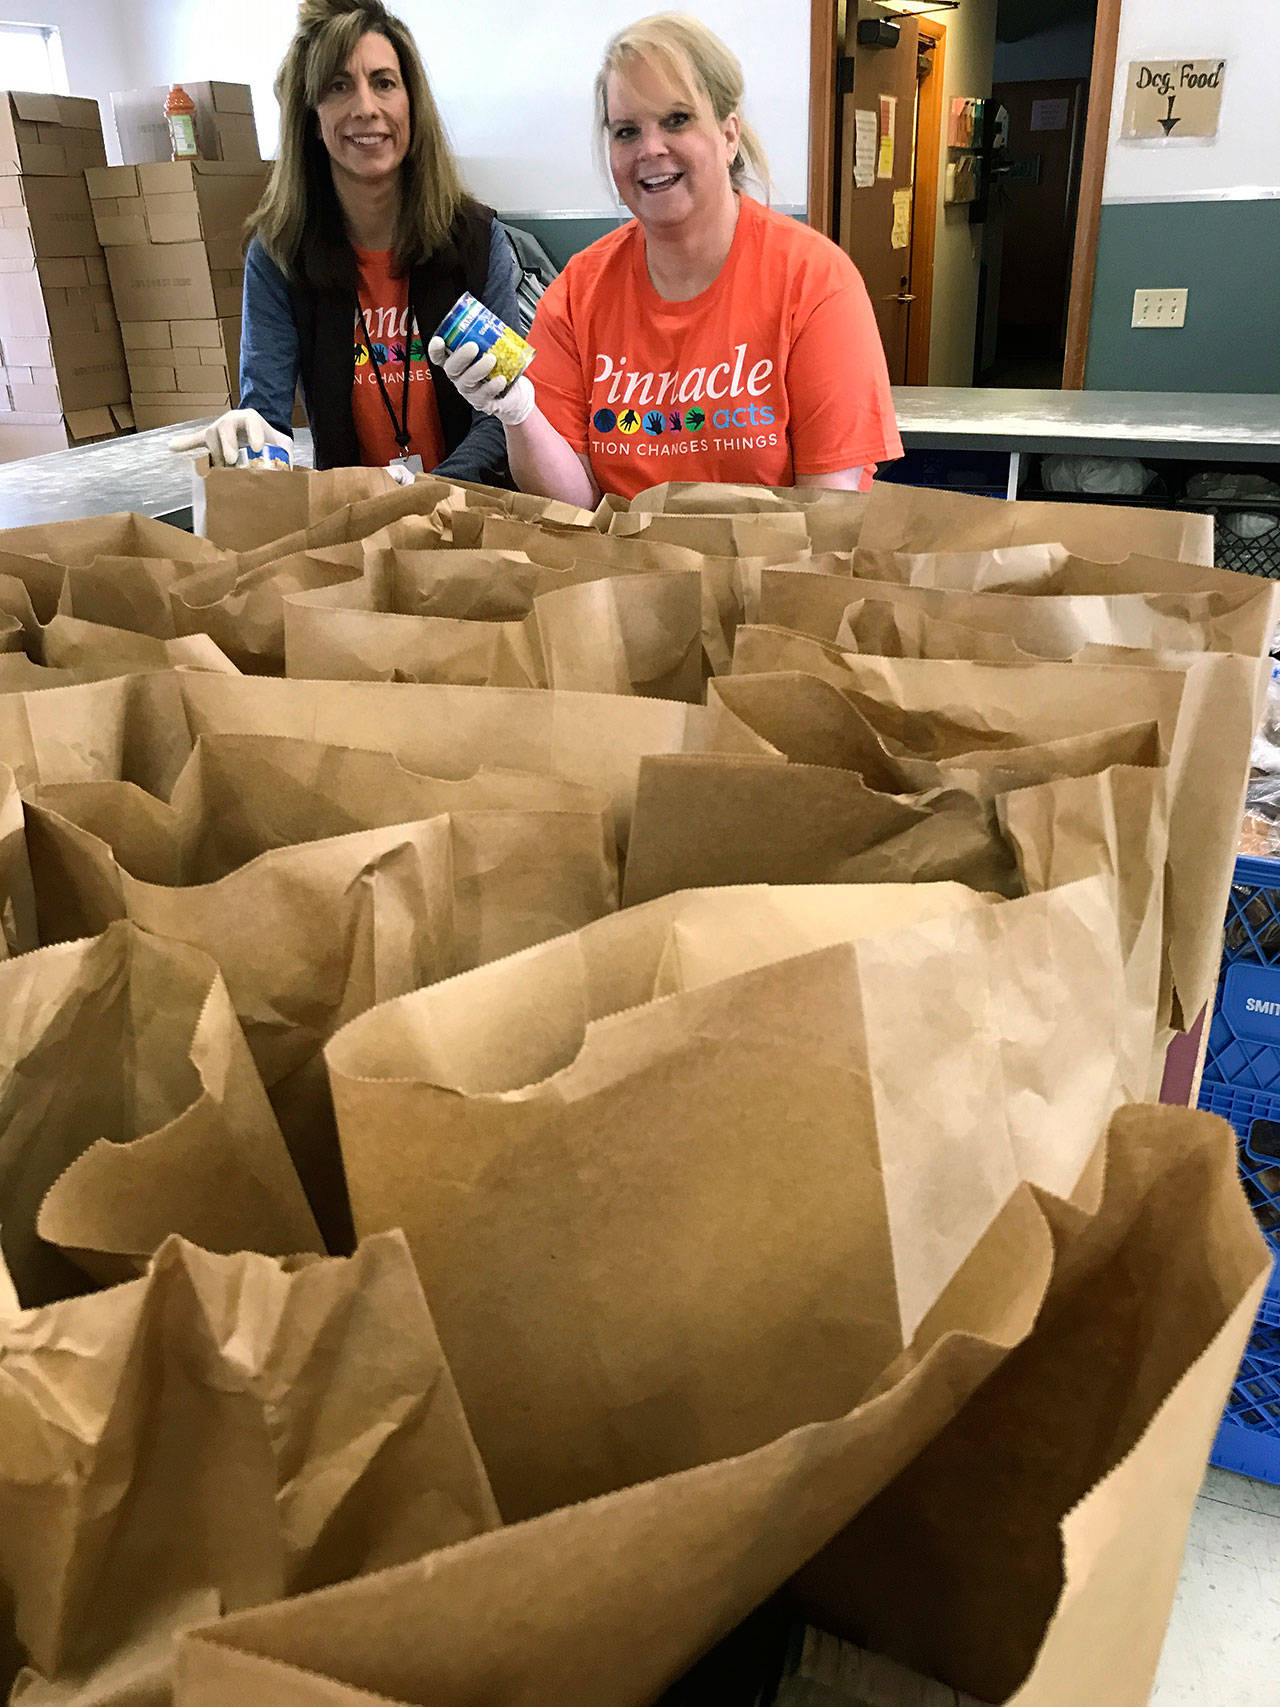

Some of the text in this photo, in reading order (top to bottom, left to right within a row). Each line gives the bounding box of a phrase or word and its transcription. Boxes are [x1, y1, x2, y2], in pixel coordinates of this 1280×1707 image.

[1136, 62, 1224, 95] Dog Food
[712, 403, 776, 429] acts
[592, 433, 778, 456] TION CHANGES THINGS
